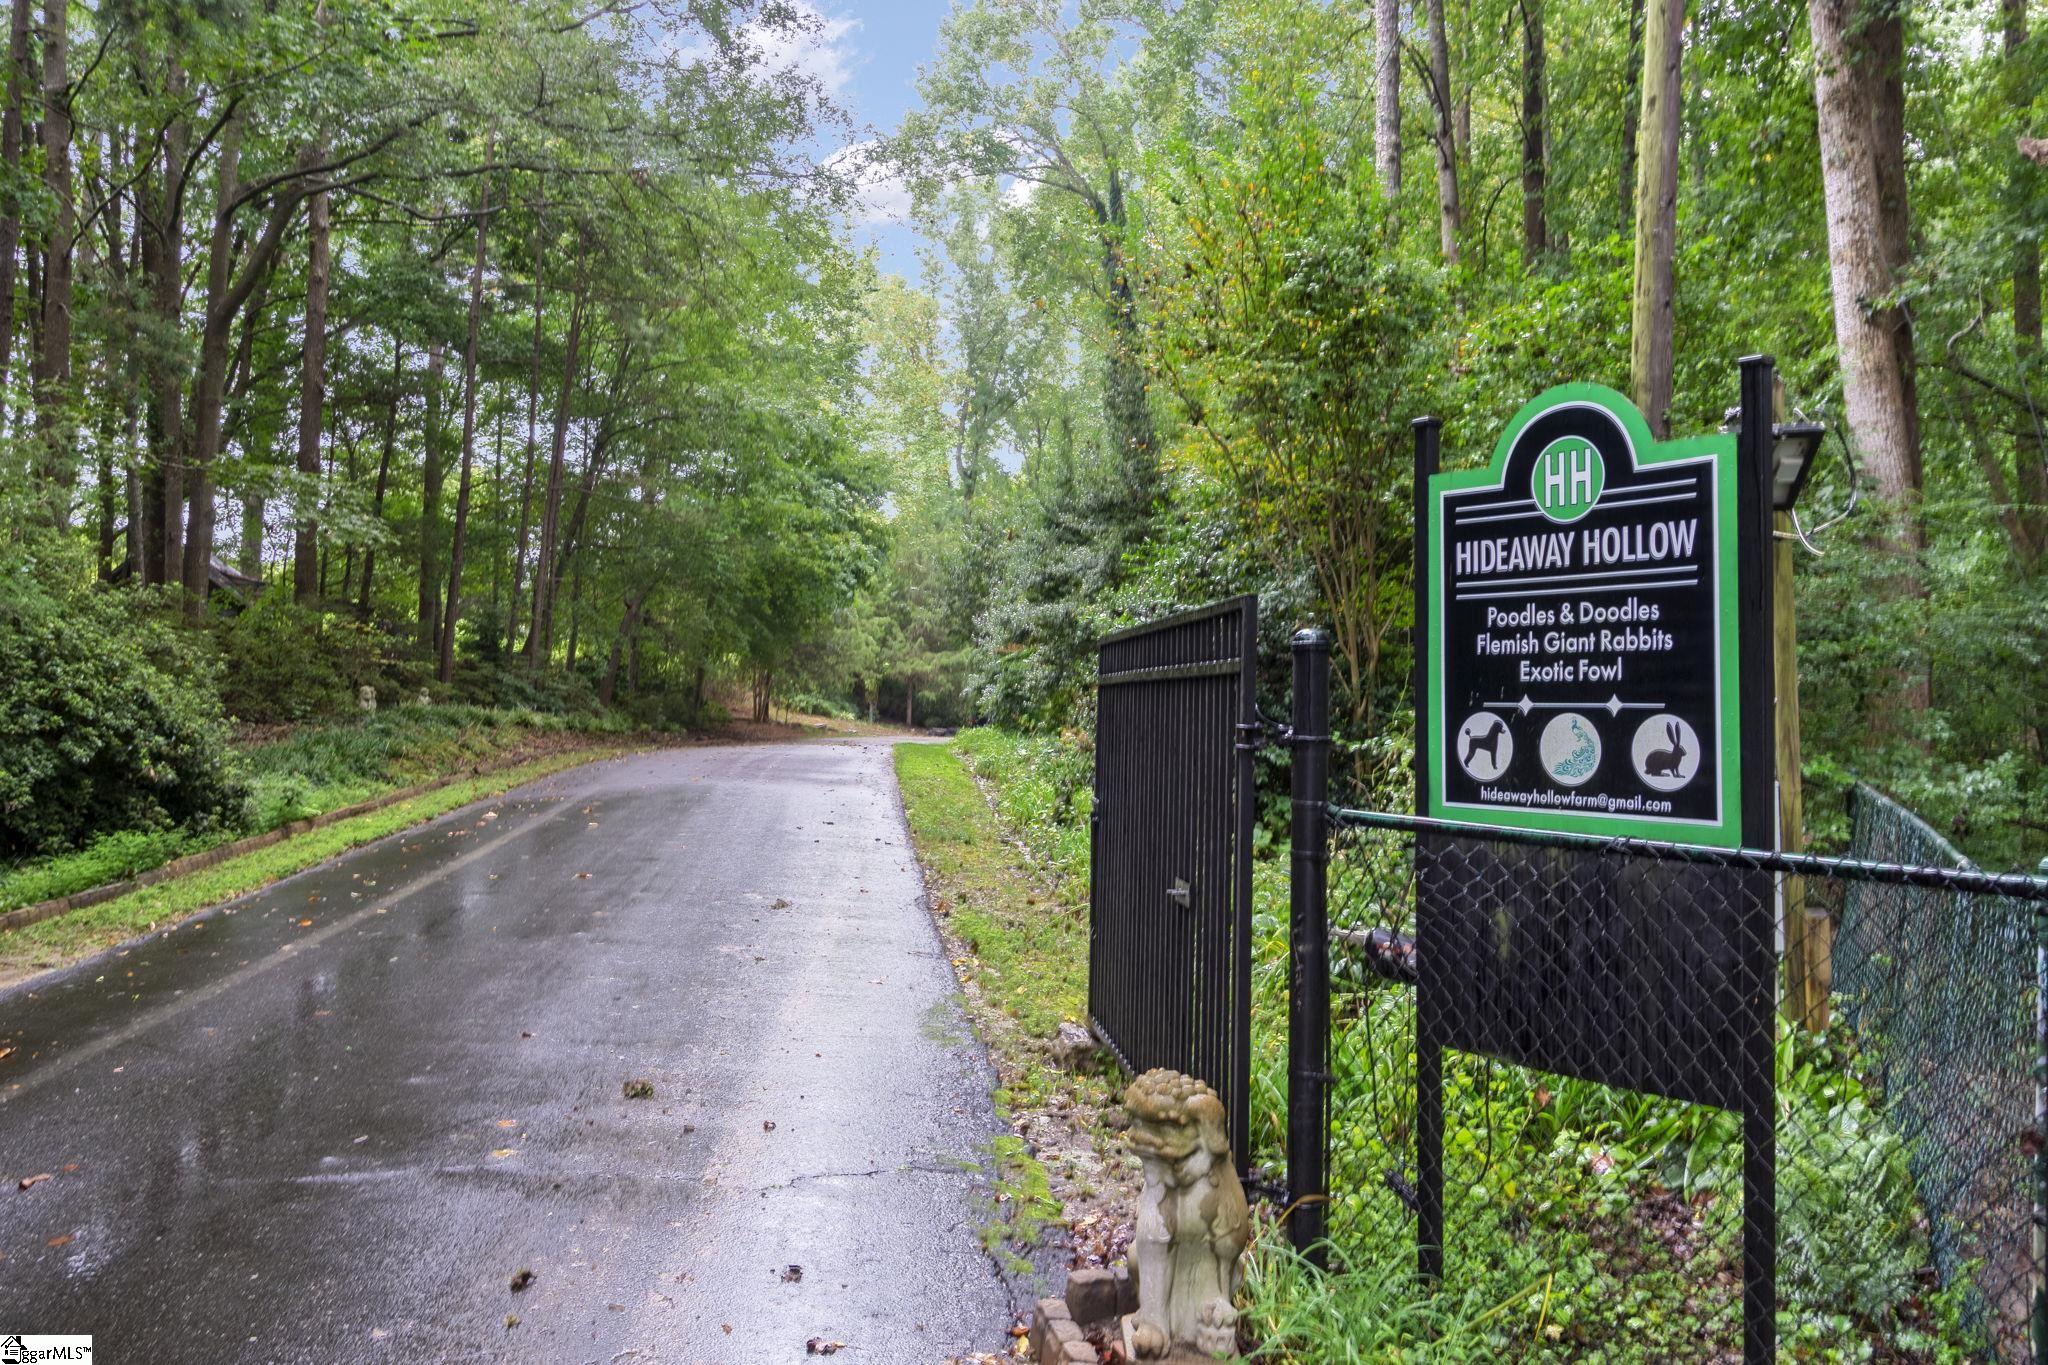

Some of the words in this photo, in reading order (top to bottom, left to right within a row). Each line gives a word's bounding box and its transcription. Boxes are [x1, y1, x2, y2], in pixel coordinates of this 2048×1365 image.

[1544, 448, 1592, 508] HH
[1456, 531, 1575, 575] HIDEAWAY
[1583, 518, 1698, 565] HOLLOW
[1487, 603, 1555, 628] Poodles
[1560, 602, 1574, 624] &
[1580, 597, 1660, 623] Doodles
[1476, 630, 1539, 656] Flemish
[1544, 631, 1595, 653] Giant
[1600, 626, 1674, 652] Rabbits
[1520, 660, 1574, 683] Exotic
[1579, 656, 1623, 682] Fowl
[1480, 785, 1672, 813] hideawayhollowfarm@gmail.com
